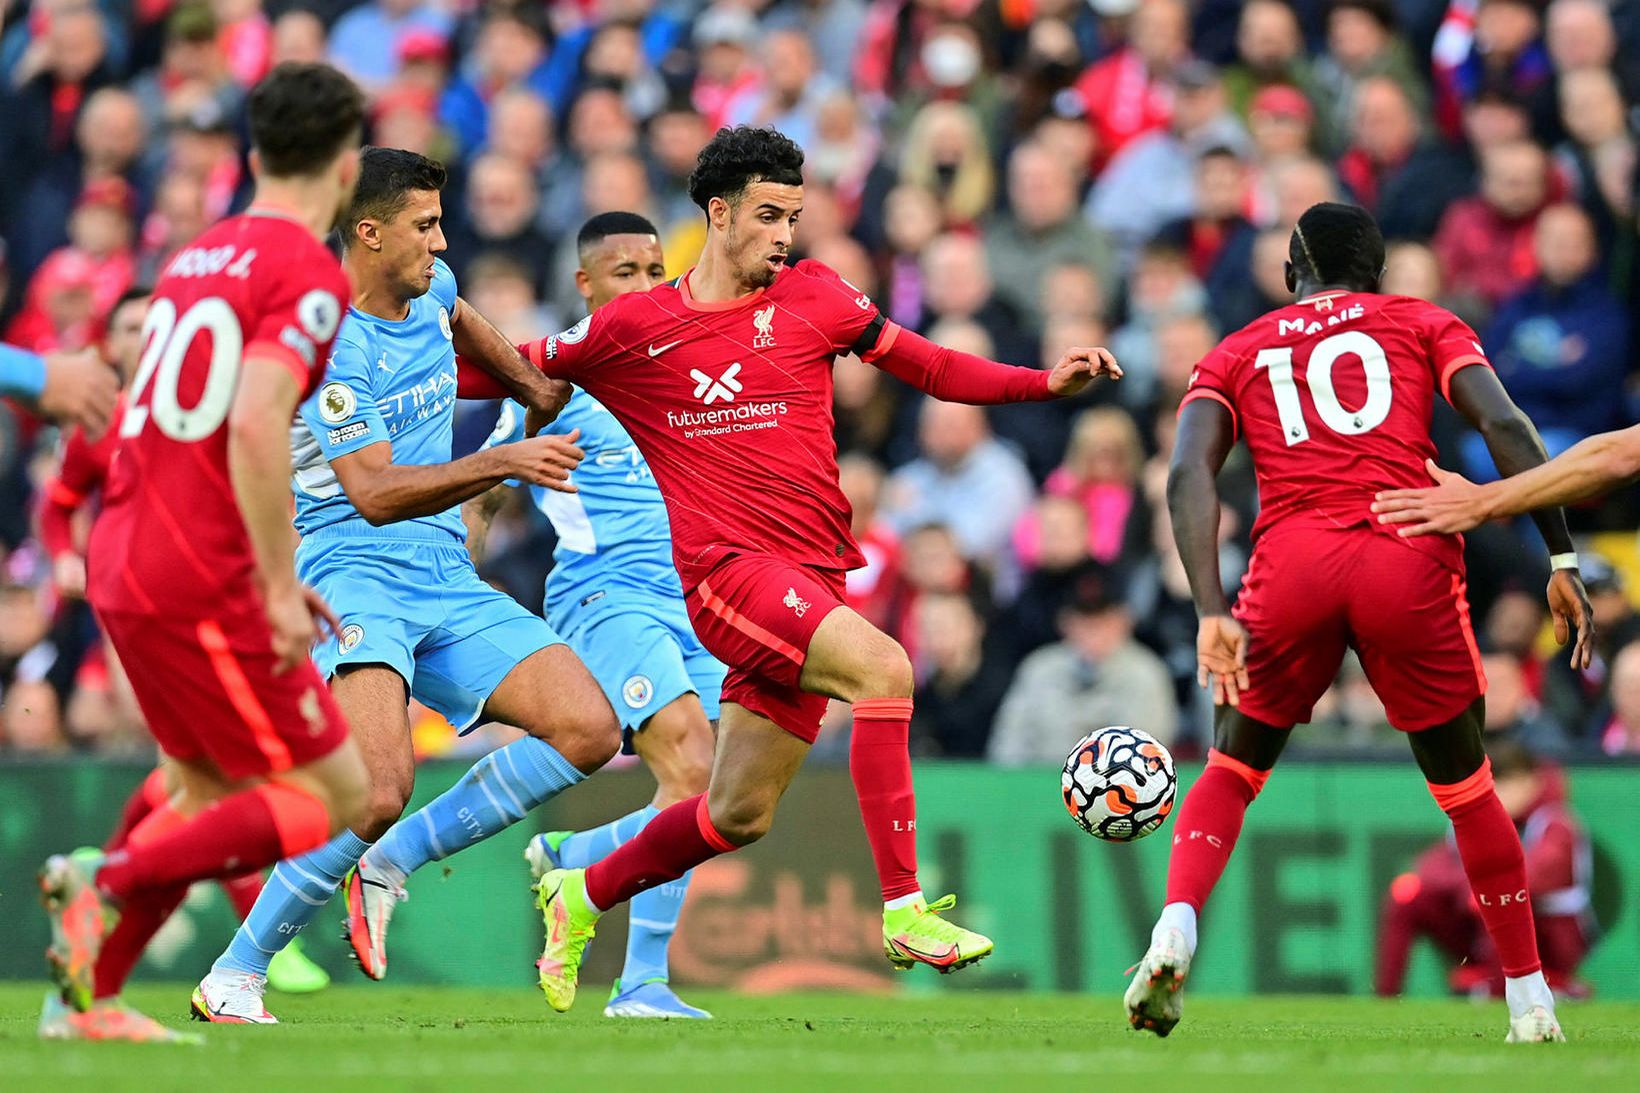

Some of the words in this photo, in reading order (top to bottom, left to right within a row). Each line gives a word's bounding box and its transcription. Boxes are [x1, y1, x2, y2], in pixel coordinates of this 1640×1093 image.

[753, 337, 777, 349] LFC
[119, 296, 243, 442] 20
[1254, 330, 1393, 447] 10
[667, 401, 788, 428] futuremakers
[684, 429, 695, 439] by
[695, 423, 731, 437] Standard
[733, 419, 778, 432] Chartered
[892, 819, 917, 832] LF
